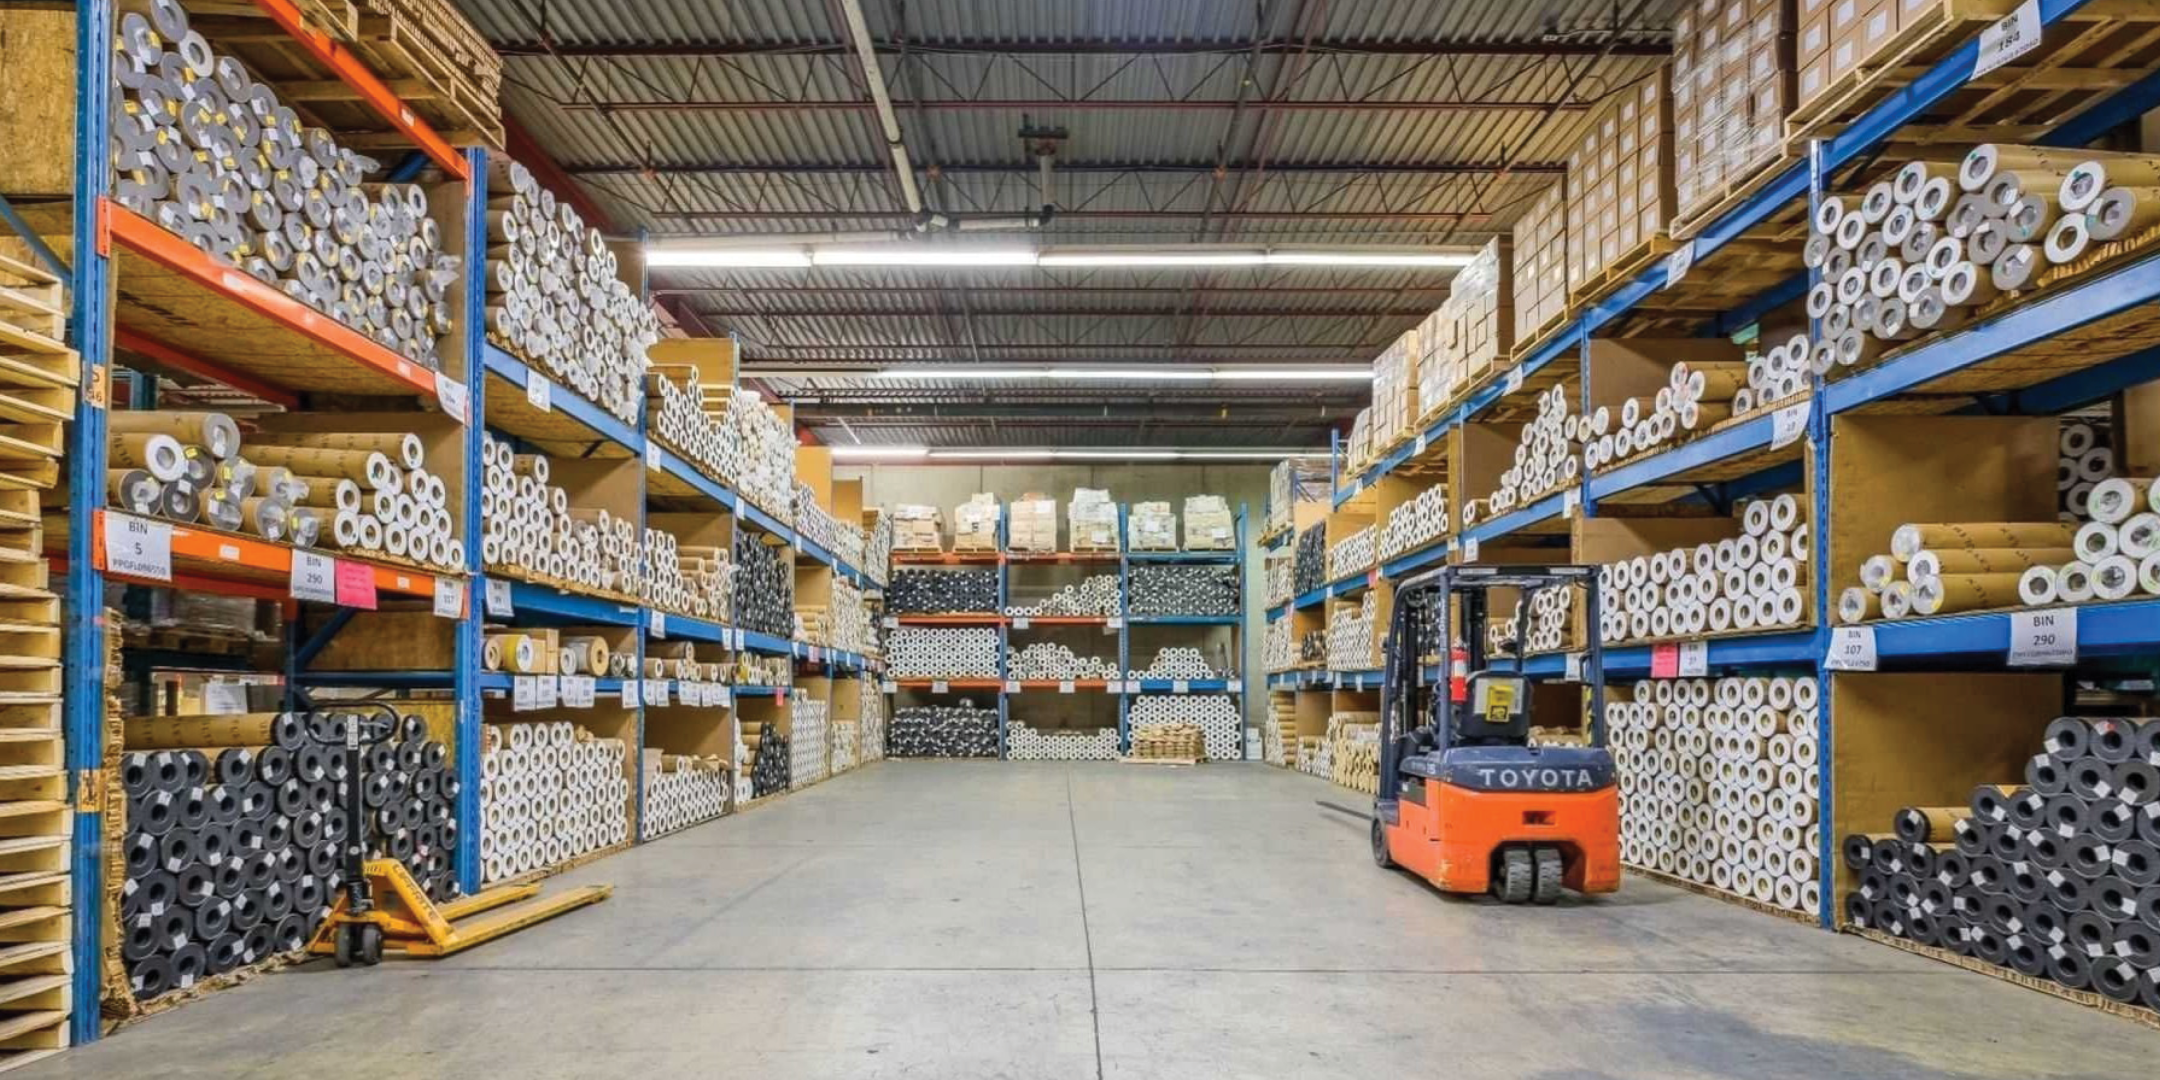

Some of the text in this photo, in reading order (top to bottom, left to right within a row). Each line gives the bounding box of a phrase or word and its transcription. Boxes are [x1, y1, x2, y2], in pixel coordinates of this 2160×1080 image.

[2001, 12, 2018, 31] BIN
[129, 521, 148, 535] BIN
[134, 542, 143, 555] 5
[306, 556, 322, 567] BIN
[2033, 615, 2054, 627] BIN
[1848, 630, 1861, 638] BIN
[2033, 634, 2056, 646] 290
[1844, 645, 1862, 655] 107
[1478, 768, 1593, 787] TOYOTA
